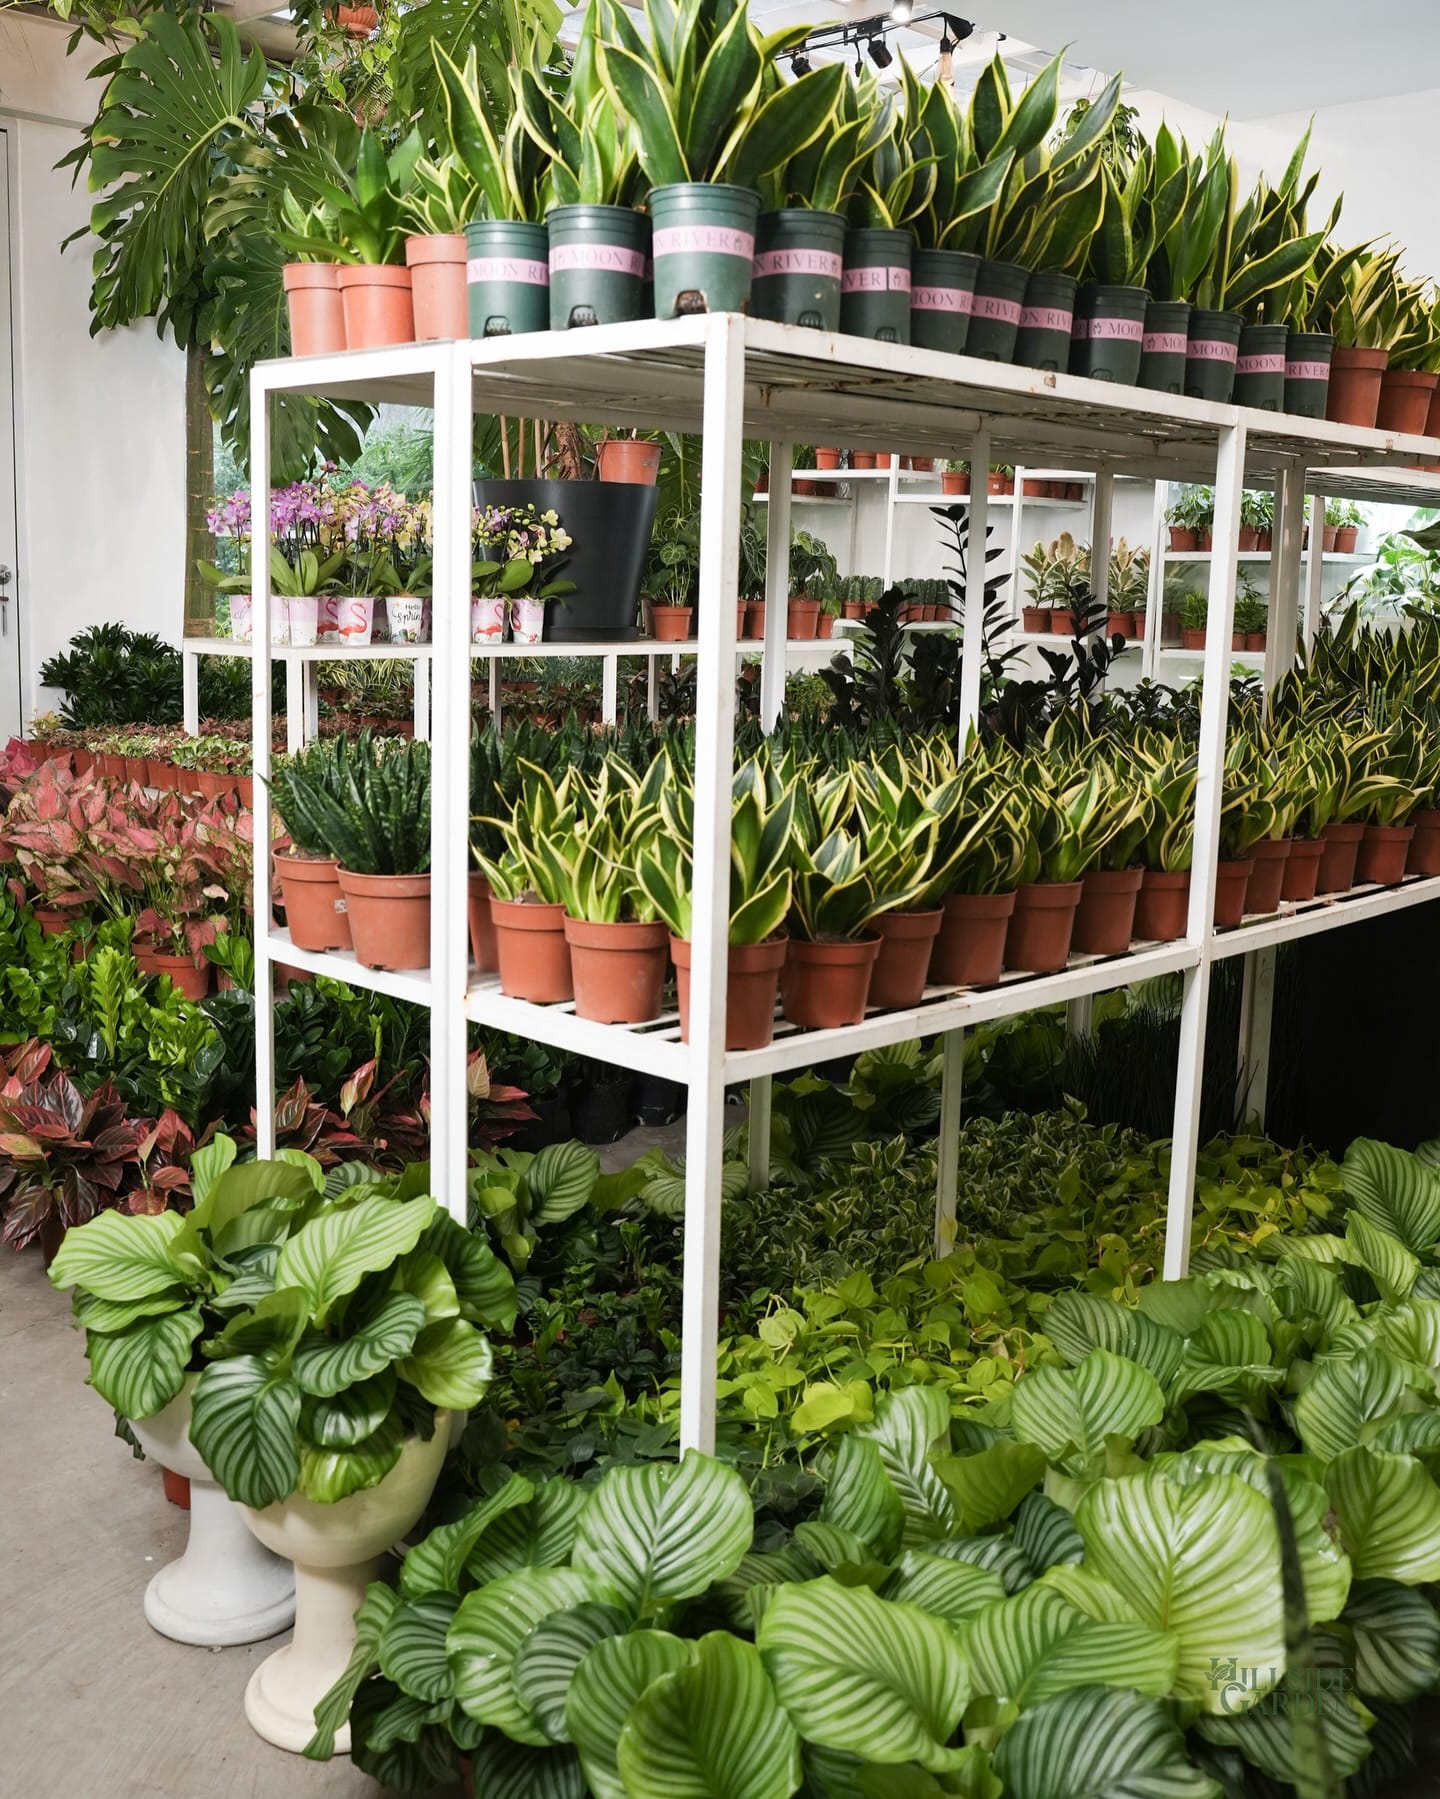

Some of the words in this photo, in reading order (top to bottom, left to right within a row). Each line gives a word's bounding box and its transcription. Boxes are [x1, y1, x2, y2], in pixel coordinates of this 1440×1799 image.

[671, 231, 729, 250] RIVER
[571, 249, 622, 266] MOON
[772, 254, 827, 271] RIVER
[1193, 343, 1230, 357] MOON
[1288, 365, 1327, 376] RIVER
